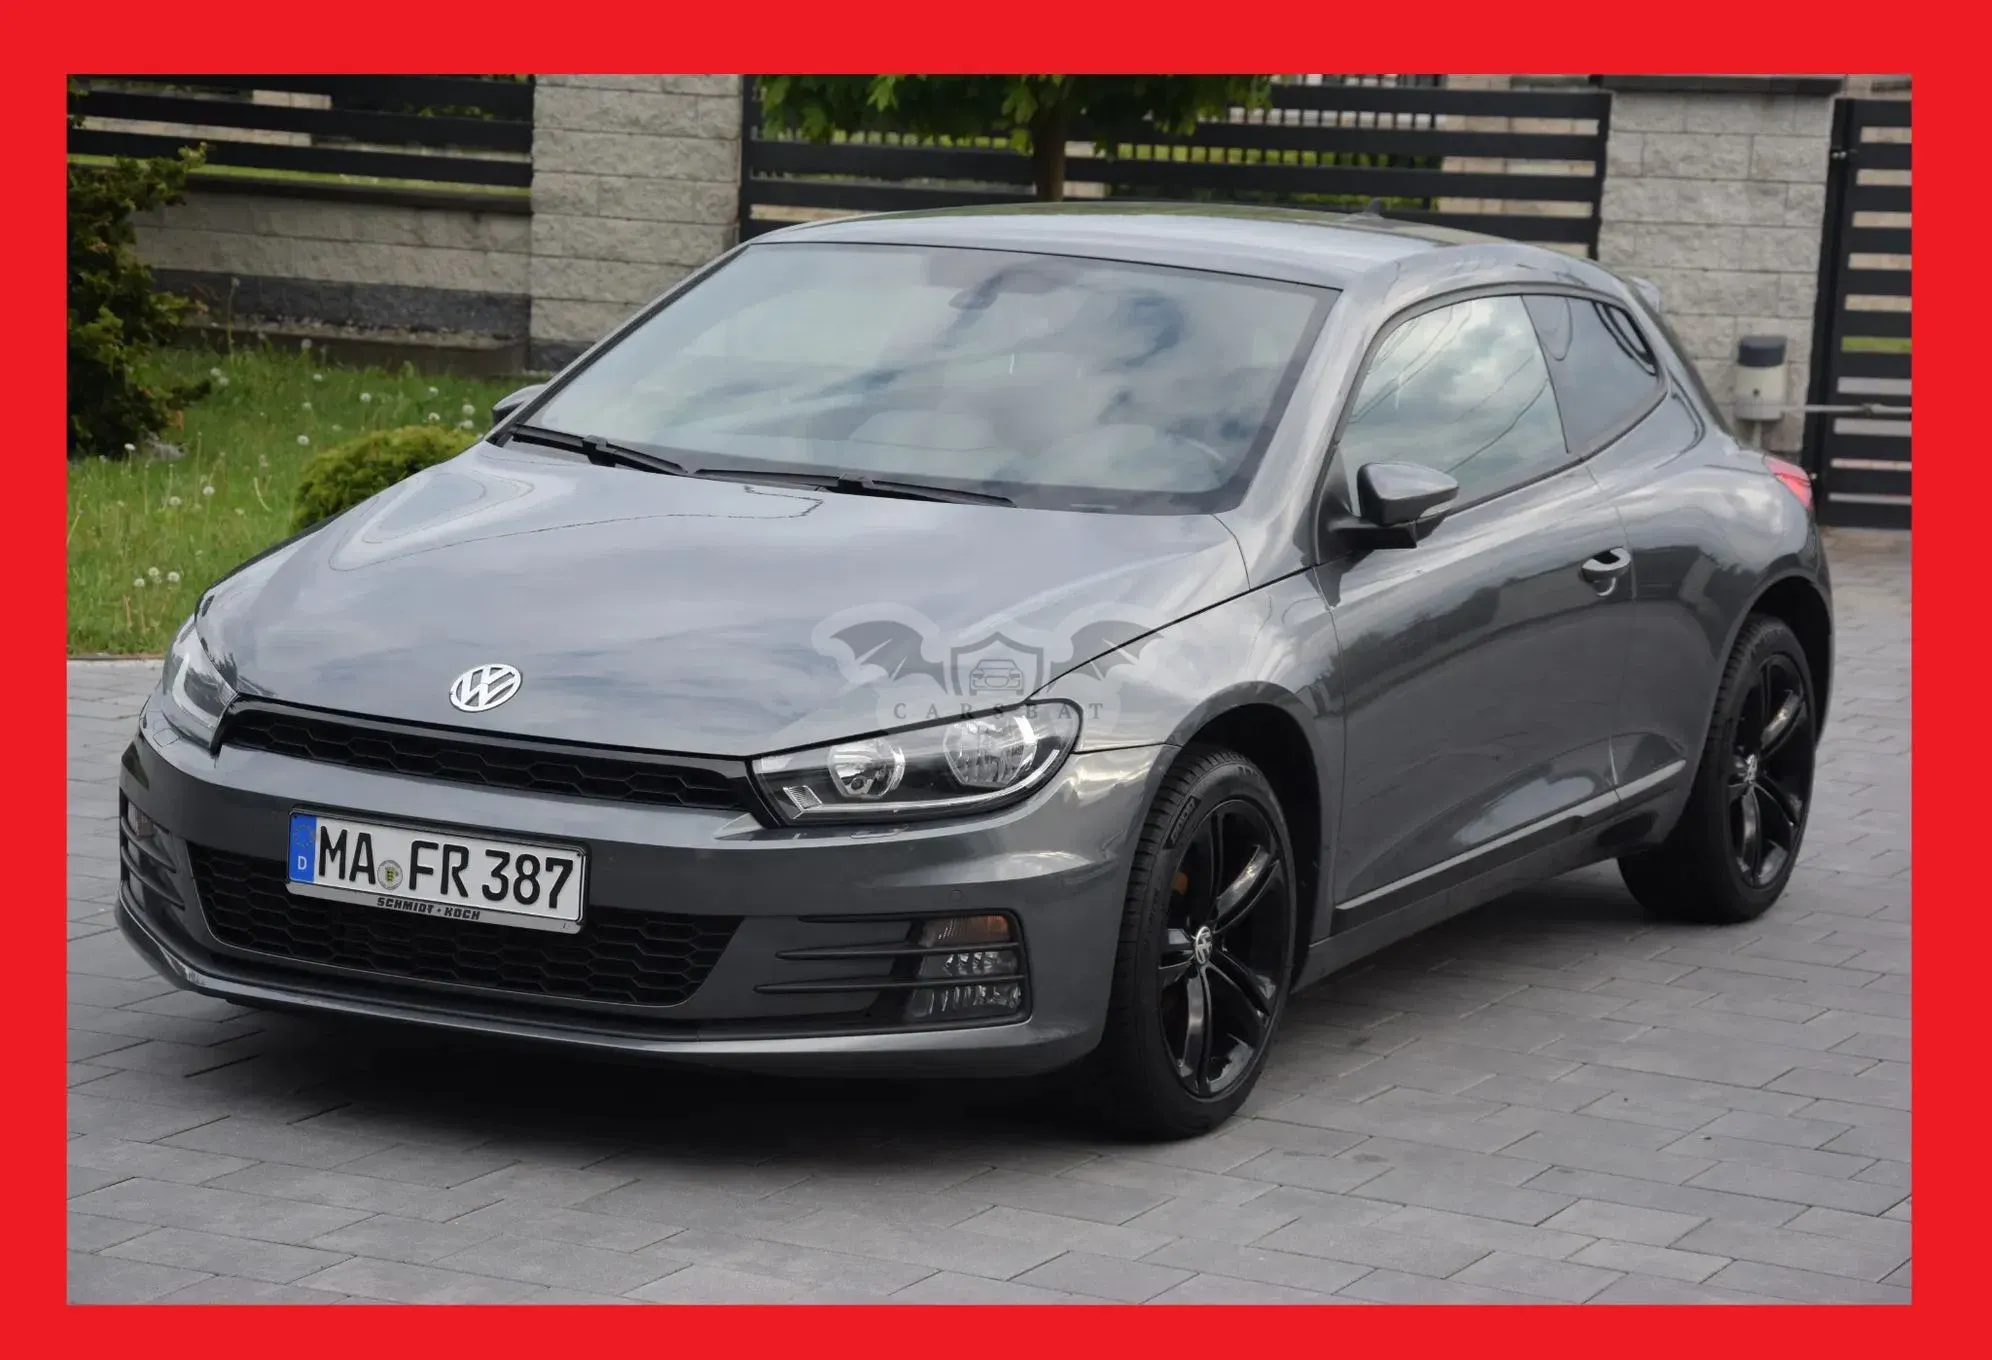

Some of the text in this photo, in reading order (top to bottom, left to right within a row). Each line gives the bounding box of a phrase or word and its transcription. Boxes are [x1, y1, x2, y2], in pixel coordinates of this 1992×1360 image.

[297, 855, 307, 871] D
[318, 825, 573, 909] MA FR 387
[377, 896, 481, 921] SCHMIDT KOCH
